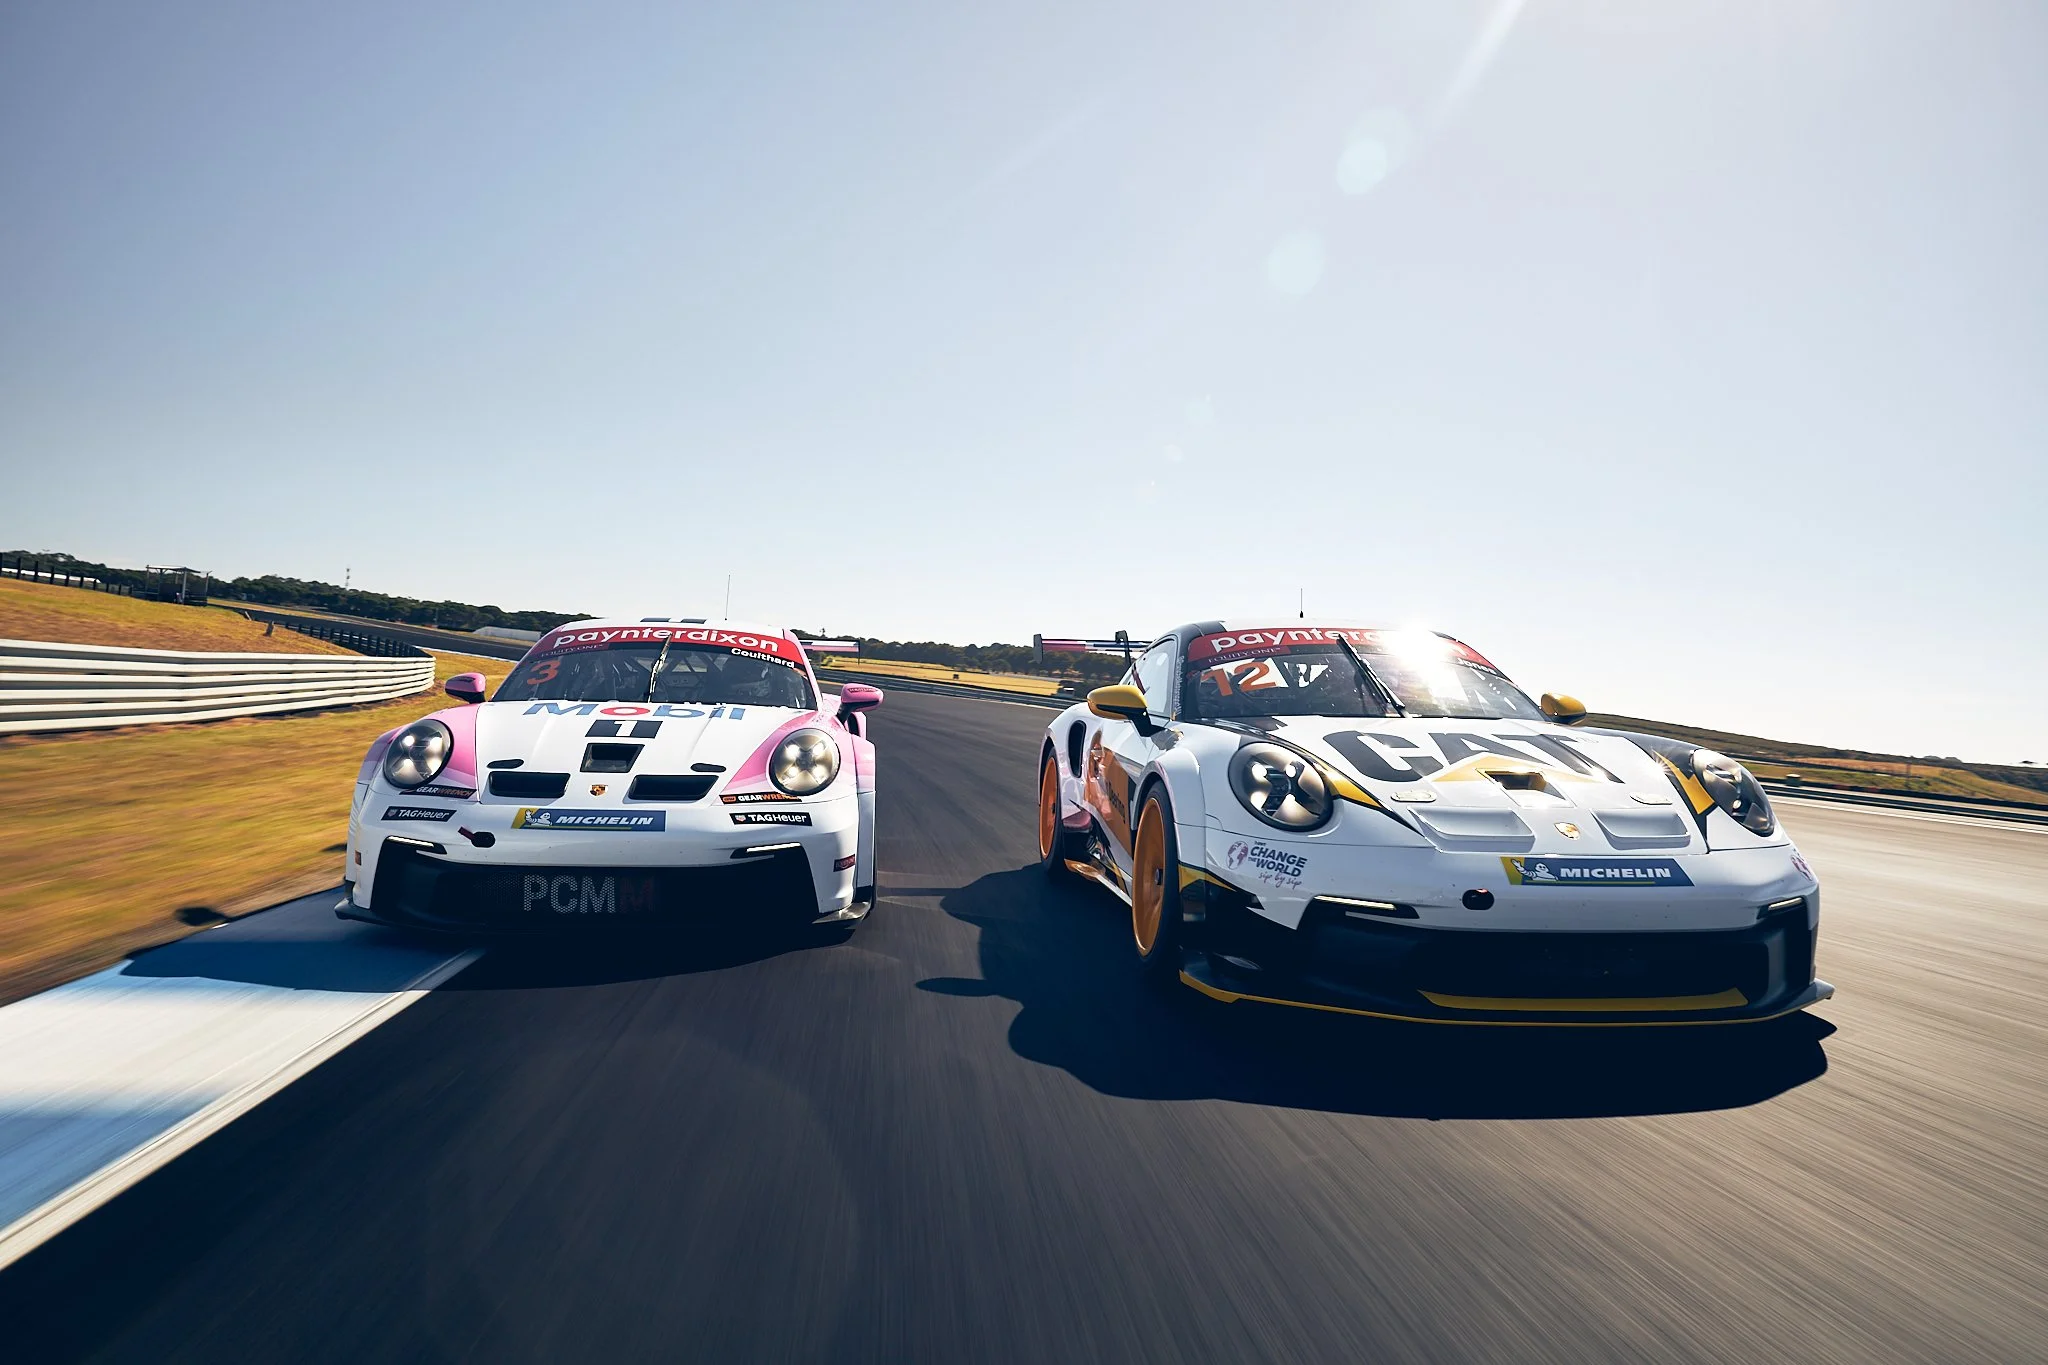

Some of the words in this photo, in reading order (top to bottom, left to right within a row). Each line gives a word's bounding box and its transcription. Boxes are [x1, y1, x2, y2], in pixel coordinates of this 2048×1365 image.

[553, 627, 778, 651] paynterdixon
[731, 647, 795, 669] Coulthard
[1208, 652, 1249, 663] EQUITY
[1457, 657, 1497, 675] Jones
[527, 660, 560, 685] 3
[1201, 661, 1276, 697] 12
[523, 702, 746, 721] Mobil
[613, 720, 638, 737] 1
[1323, 730, 1626, 784] CAT
[416, 786, 472, 797] GEARWRENCH
[555, 815, 654, 826] MICHELIN
[1250, 846, 1308, 868] CHANGE
[1256, 858, 1302, 877] WORLD
[1560, 868, 1672, 878] MICHELIN
[1258, 871, 1273, 883] sip
[1274, 873, 1286, 888] by
[1286, 877, 1302, 890] sip
